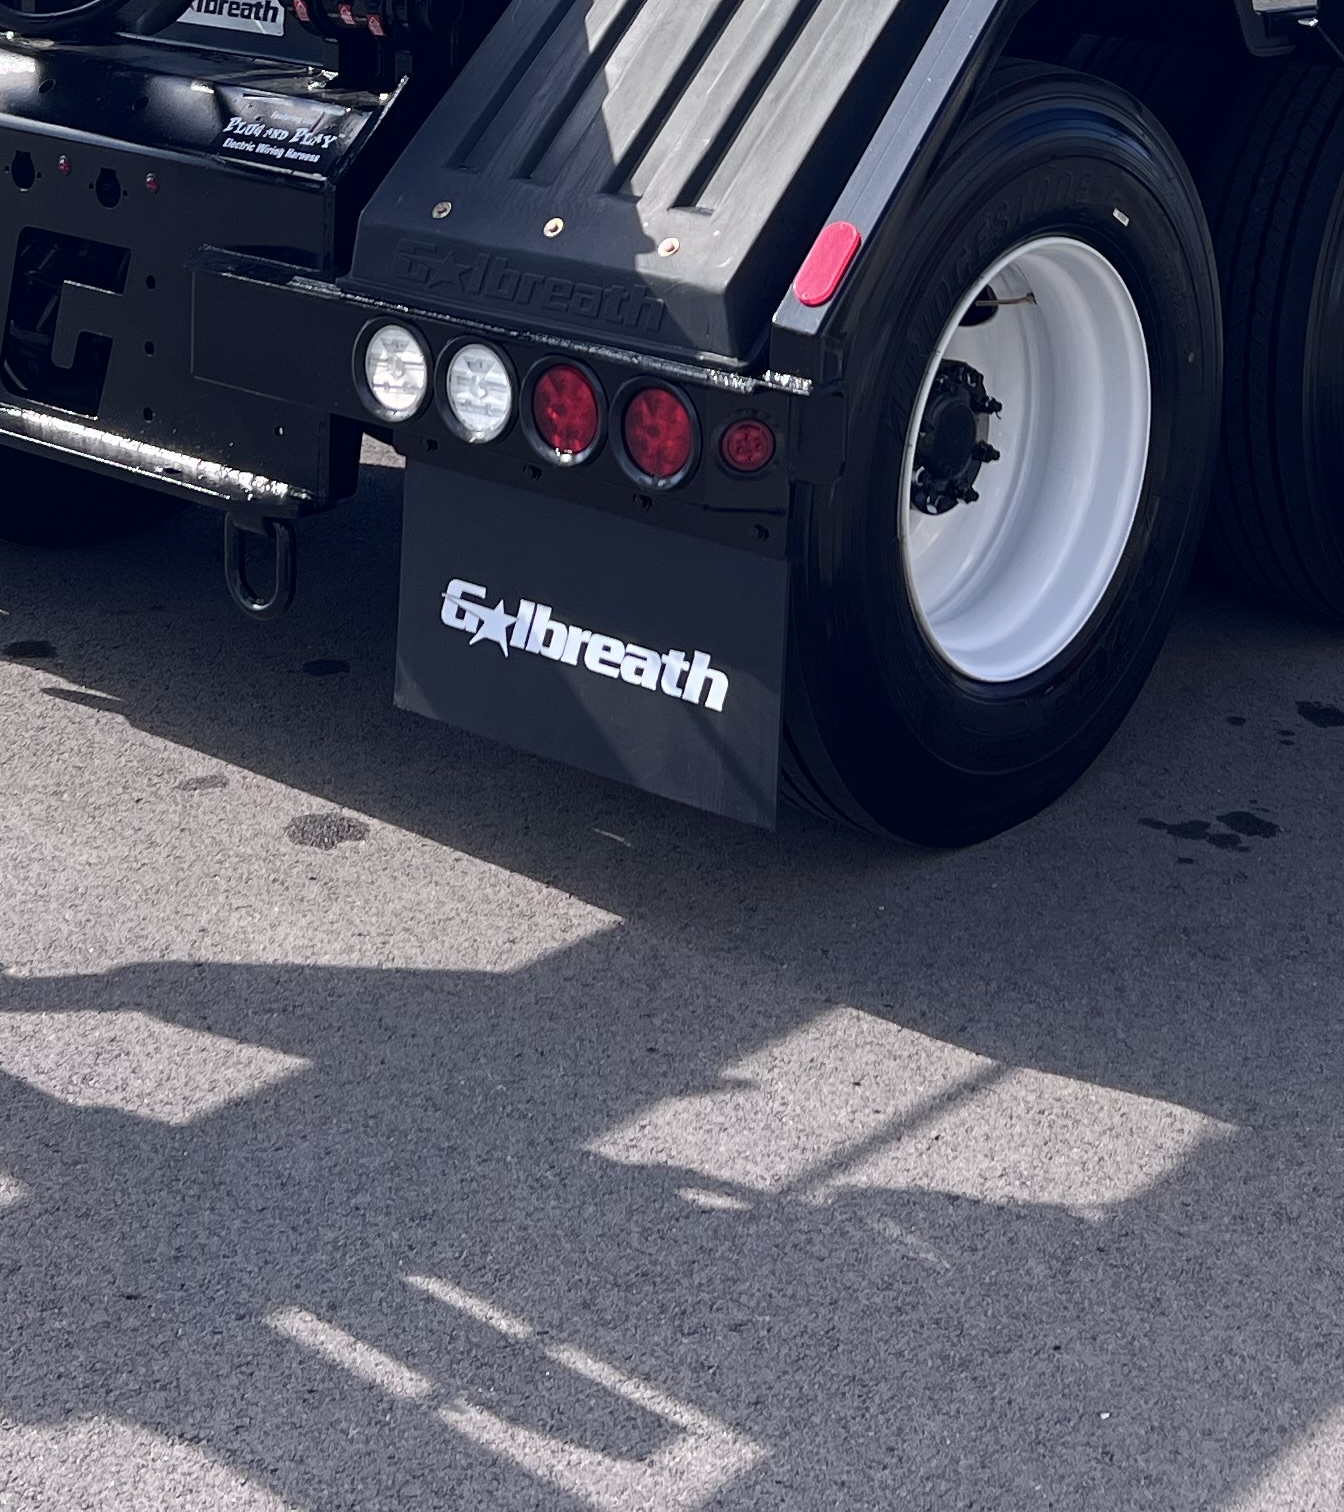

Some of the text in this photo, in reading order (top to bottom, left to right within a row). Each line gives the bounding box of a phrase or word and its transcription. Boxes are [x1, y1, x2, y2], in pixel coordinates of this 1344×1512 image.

[223, 117, 337, 148] PLUG AND PLAY
[222, 137, 321, 163] Electric Wiring Harness
